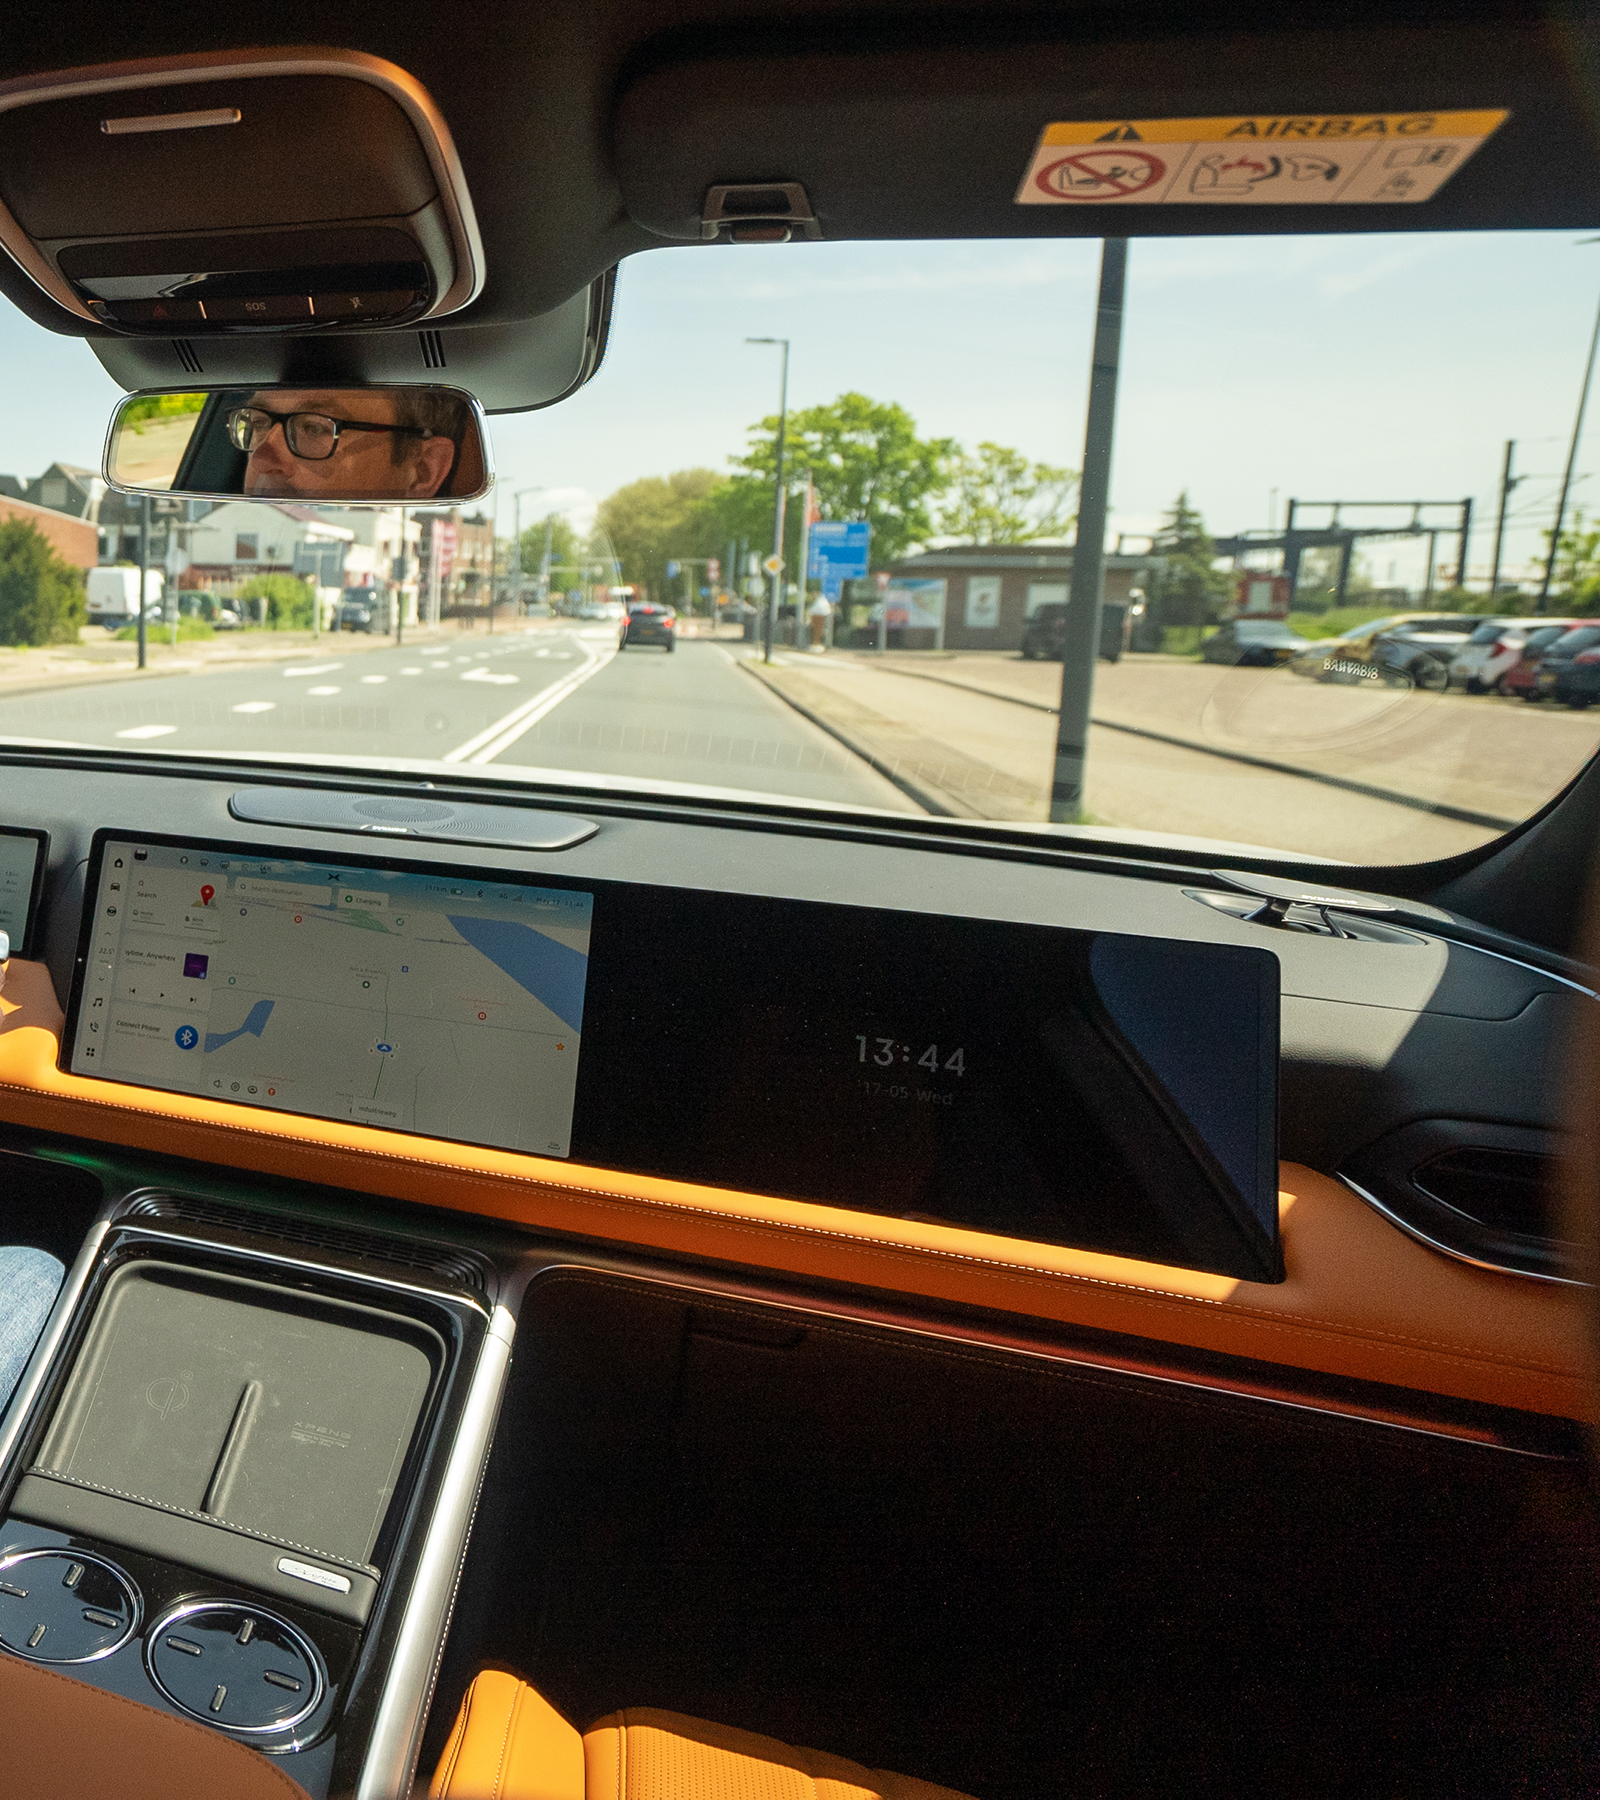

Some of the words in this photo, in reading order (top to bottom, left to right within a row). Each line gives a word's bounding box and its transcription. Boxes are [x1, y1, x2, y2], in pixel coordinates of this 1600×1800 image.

[1223, 116, 1438, 138] AIRBAG
[245, 302, 266, 311] SOS
[136, 891, 157, 899] Search
[355, 896, 382, 906] Charging
[116, 1020, 141, 1029] Connect
[141, 1024, 161, 1033] Phone
[855, 1034, 966, 1077] 13:44
[864, 1081, 909, 1099] 17-05
[916, 1088, 953, 1106] Wed
